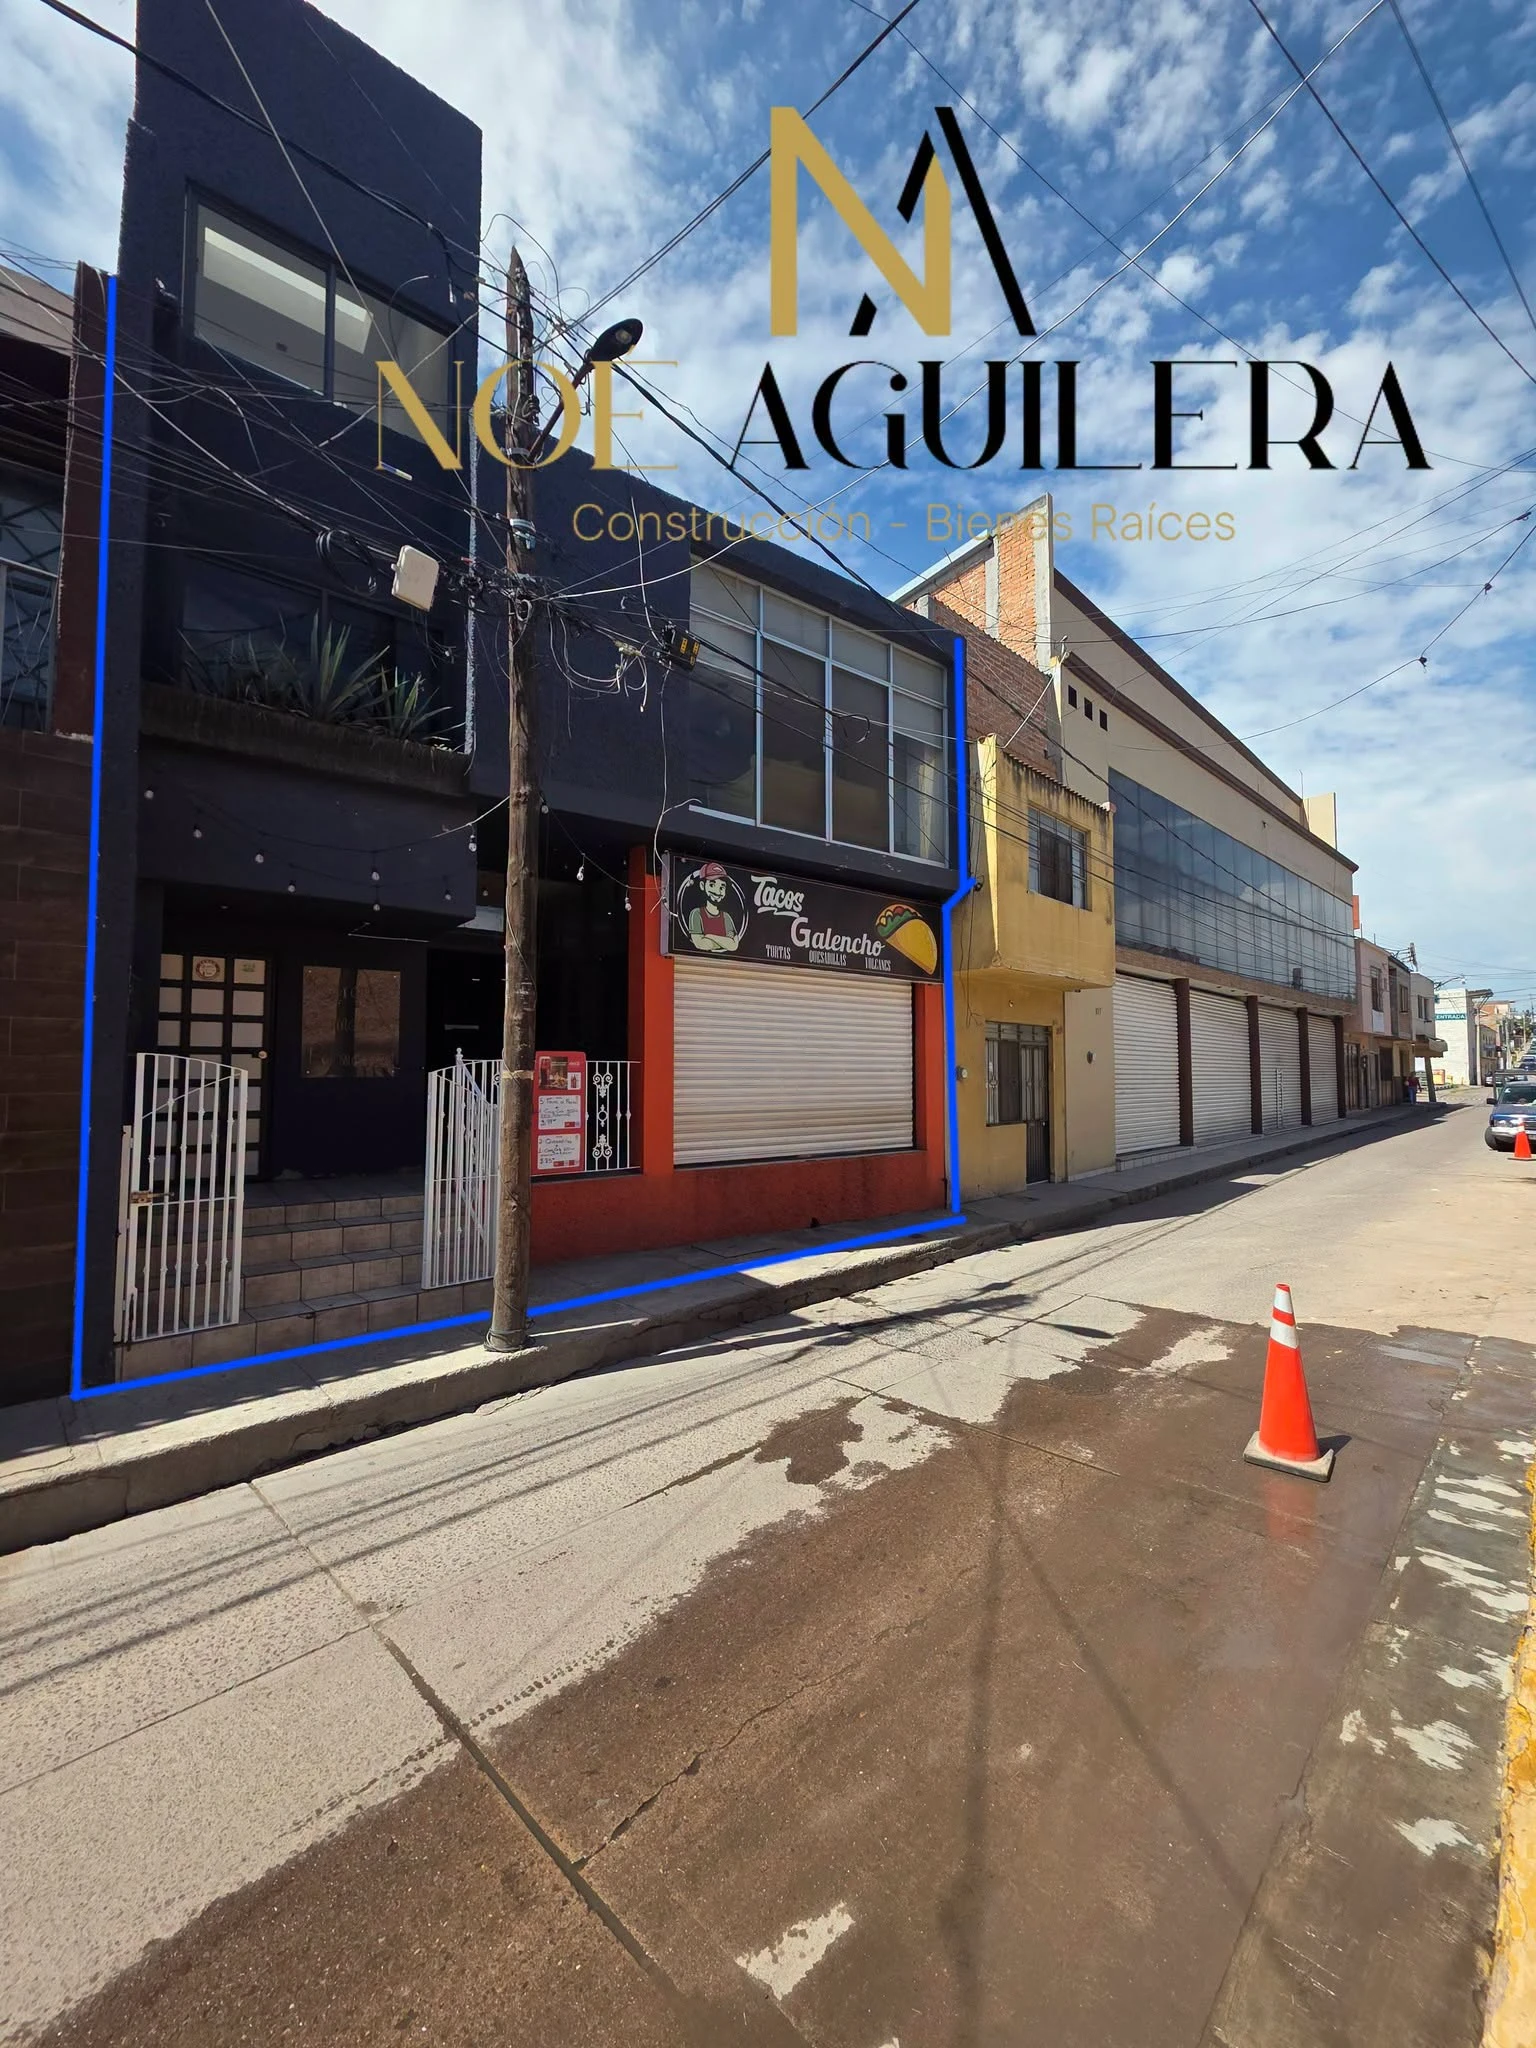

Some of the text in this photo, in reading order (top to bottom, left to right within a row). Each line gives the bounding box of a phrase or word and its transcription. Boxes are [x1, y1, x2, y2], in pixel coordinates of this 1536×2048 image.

[750, 875, 805, 914] Tacos
[766, 944, 791, 959] TORTAS
[809, 950, 847, 966] QUESADILLAS
[790, 917, 885, 957] Galencho
